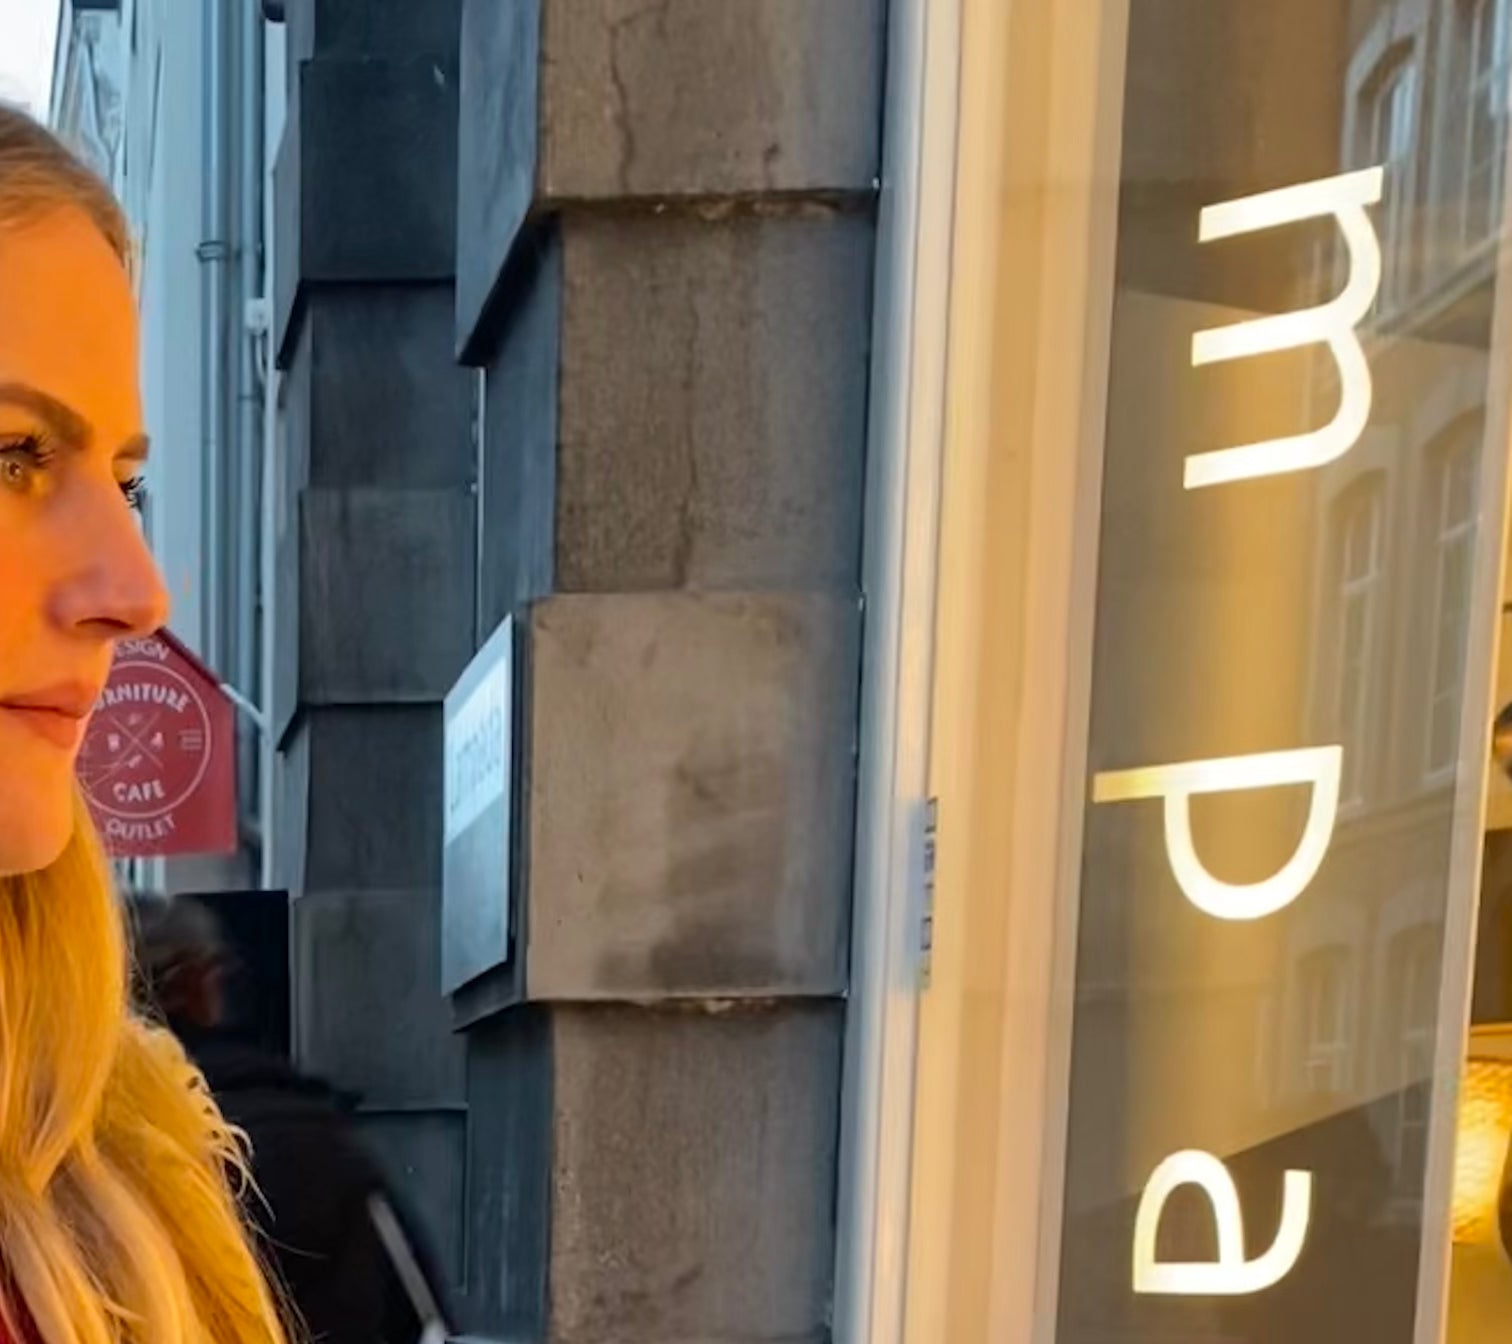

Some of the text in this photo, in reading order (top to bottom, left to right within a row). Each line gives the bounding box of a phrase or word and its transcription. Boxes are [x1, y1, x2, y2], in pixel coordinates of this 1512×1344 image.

[115, 639, 170, 661] ESIGN
[95, 683, 188, 712] RNITURE
[113, 781, 165, 802] CAFE
[107, 814, 175, 840] OUTLET
